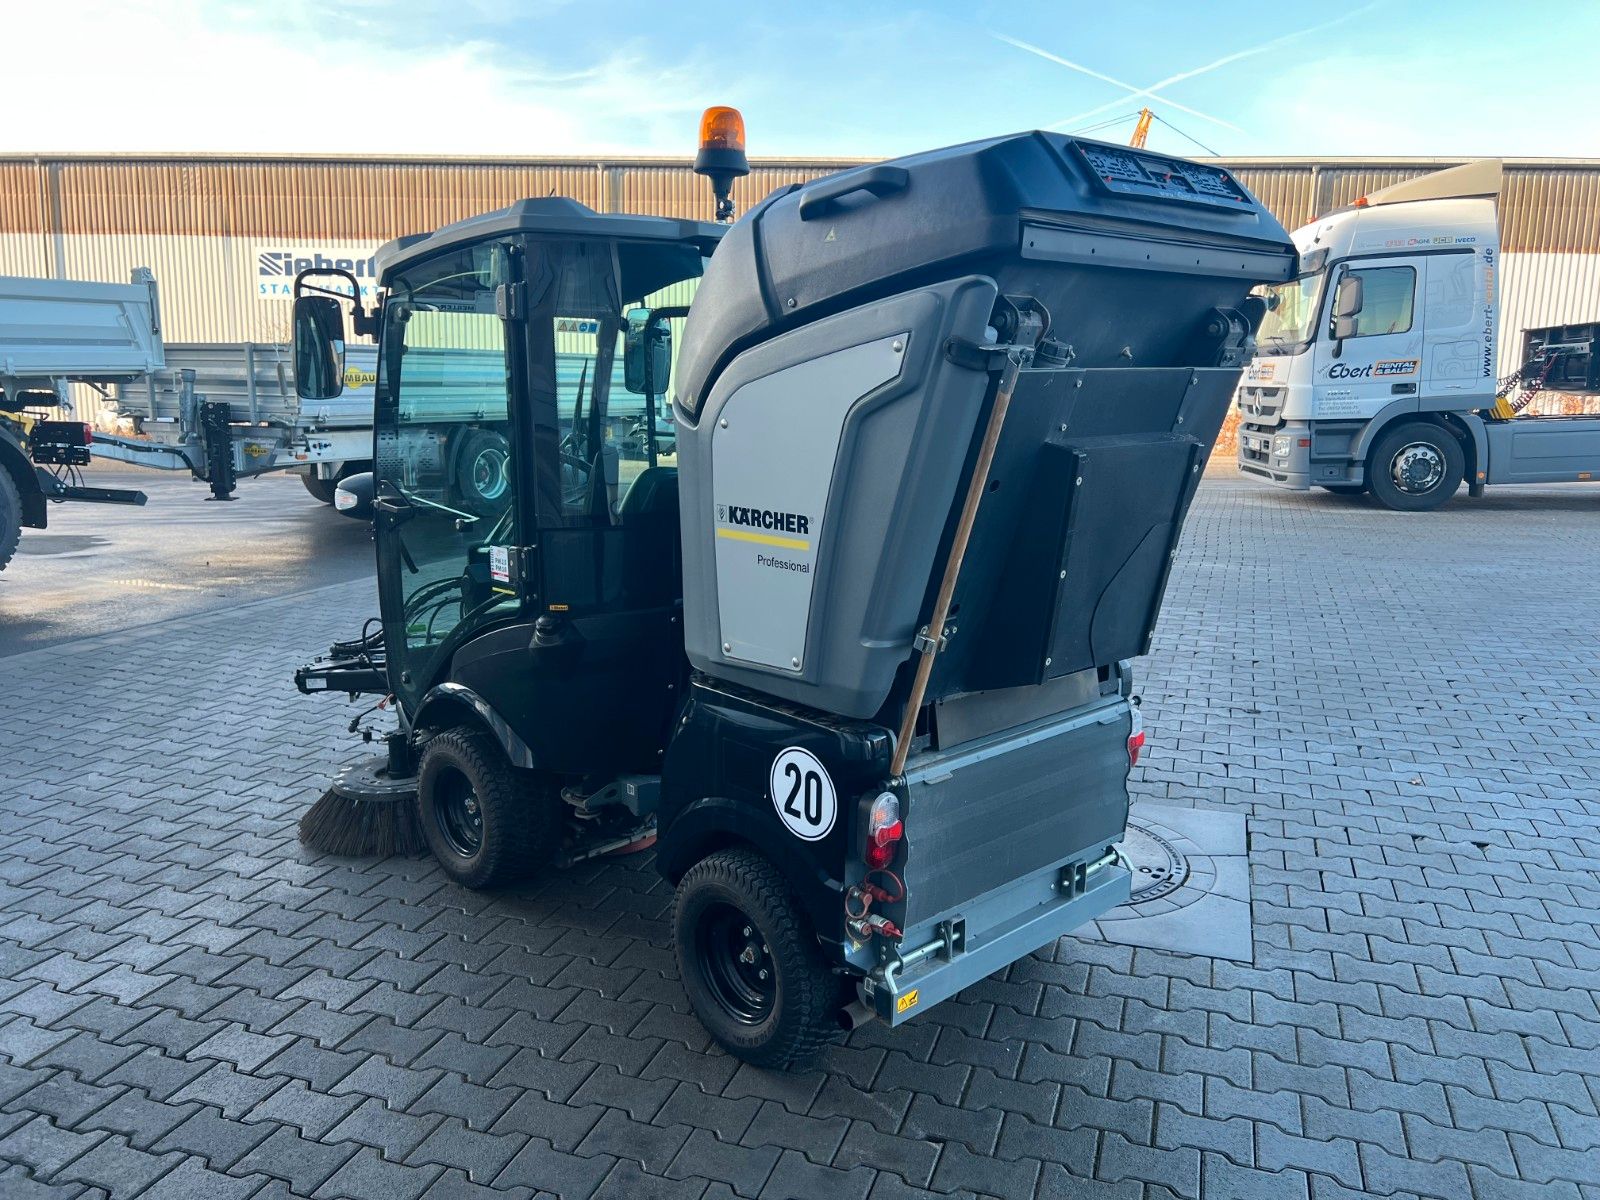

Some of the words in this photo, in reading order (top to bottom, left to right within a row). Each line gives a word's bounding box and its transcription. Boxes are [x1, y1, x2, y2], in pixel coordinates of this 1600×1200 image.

[1455, 236, 1476, 244] IVECO
[1482, 247, 1494, 377] www.ebert-rental.de
[1328, 363, 1373, 379] Ebert
[1377, 361, 1416, 369] RENTAL
[345, 374, 376, 382] MBAU
[728, 505, 809, 534] KÄRCHER
[757, 554, 810, 574] Professional
[784, 762, 822, 826] 20
